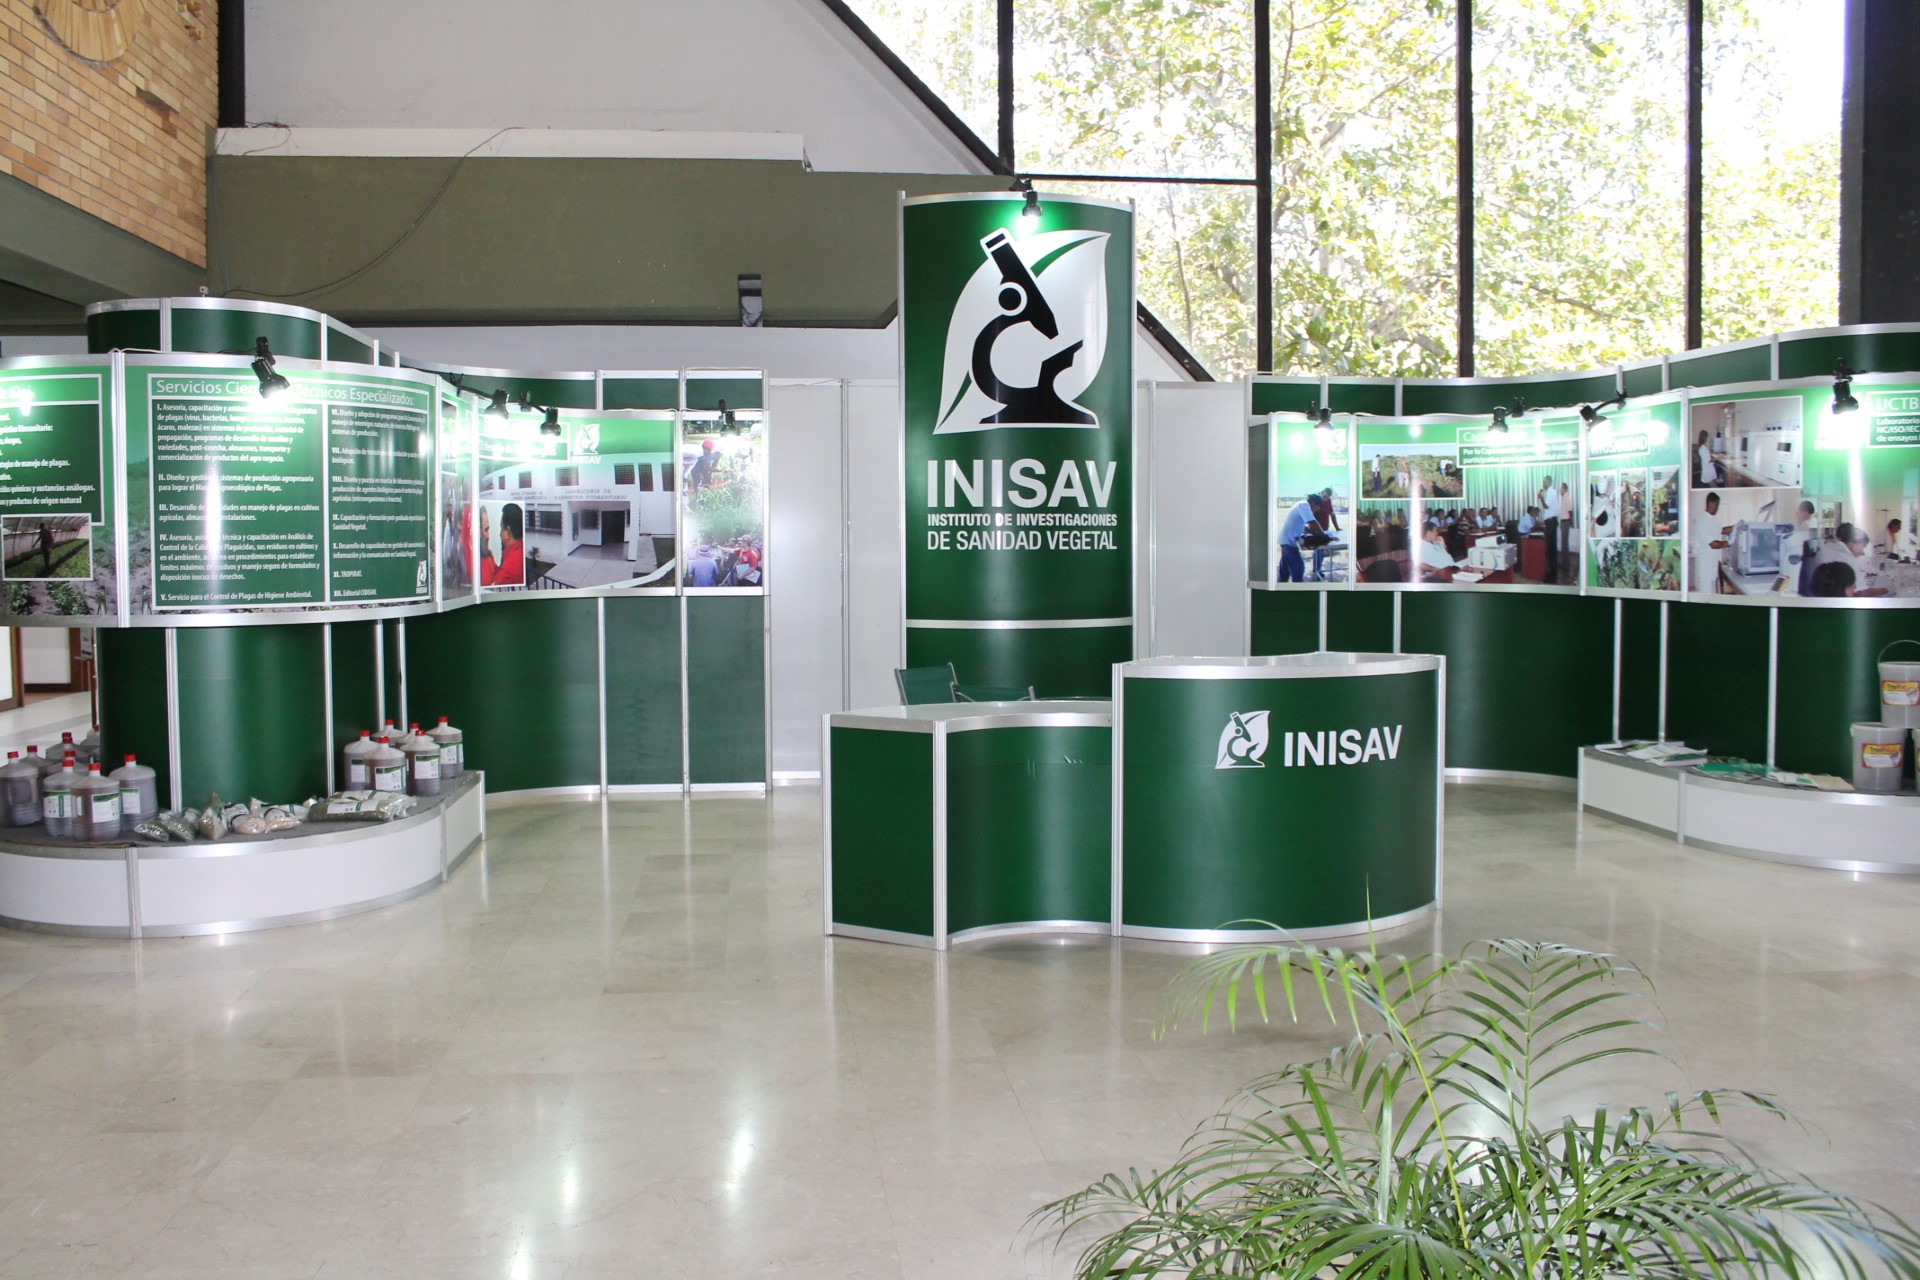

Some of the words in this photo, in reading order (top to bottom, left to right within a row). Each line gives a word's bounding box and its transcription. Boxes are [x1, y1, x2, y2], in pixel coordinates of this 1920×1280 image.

[157, 380, 222, 394] Servicios
[295, 384, 347, 398] Técnicos
[350, 387, 415, 406] Especializados:
[163, 404, 187, 412] Asesoría,
[188, 404, 223, 413] capacitación
[1876, 398, 1919, 411] UCTB
[165, 414, 183, 422] plagas
[202, 414, 229, 422] bacterias,
[1876, 418, 1920, 426] Laboratorio
[332, 419, 348, 427] manejo
[177, 424, 202, 432] malezas)
[1876, 426, 1920, 434] NC/ISO/IEC
[158, 434, 193, 442] propagación,
[1876, 434, 1886, 442] de
[1888, 435, 1918, 443] ensayos
[212, 454, 239, 462] productos
[21, 460, 40, 468] manejo
[49, 459, 70, 468] plagas.
[928, 458, 1117, 508] INISAV
[11, 485, 31, 494] químicos
[36, 484, 65, 492] sustancias
[66, 483, 95, 493] análogas.
[172, 484, 188, 492] lograr
[264, 484, 282, 492] Plagas.
[9, 498, 32, 506] productos
[41, 497, 58, 506] origen
[60, 496, 81, 504] natural
[248, 504, 268, 512] manejo
[277, 504, 293, 512] plagas
[159, 514, 185, 522] agrícolas,
[341, 514, 366, 522] Capacitación
[928, 513, 991, 527] INSTITUTO
[995, 513, 1012, 526] DE
[1017, 513, 1117, 527] INVESTIGACIONES
[169, 534, 194, 542] Asesoría,
[247, 534, 279, 542] capacitación
[928, 531, 950, 550] DE
[956, 530, 1042, 550] SANIDAD
[1046, 530, 1117, 550] VEGETAL
[224, 543, 256, 552] Plaguicidas,
[174, 553, 202, 561] ambiente,
[236, 553, 276, 561] procedimientos
[290, 552, 315, 560] establecer
[180, 563, 205, 571] máximos
[242, 563, 262, 571] manejo
[263, 563, 280, 571] seguro
[160, 574, 191, 582] disposición
[190, 594, 202, 602] para
[204, 593, 209, 601] el
[231, 592, 238, 600] de
[239, 592, 256, 601] Plagas
[265, 591, 284, 600] Higiene
[286, 590, 312, 598] Ambiental.
[1284, 725, 1403, 767] INISAV
